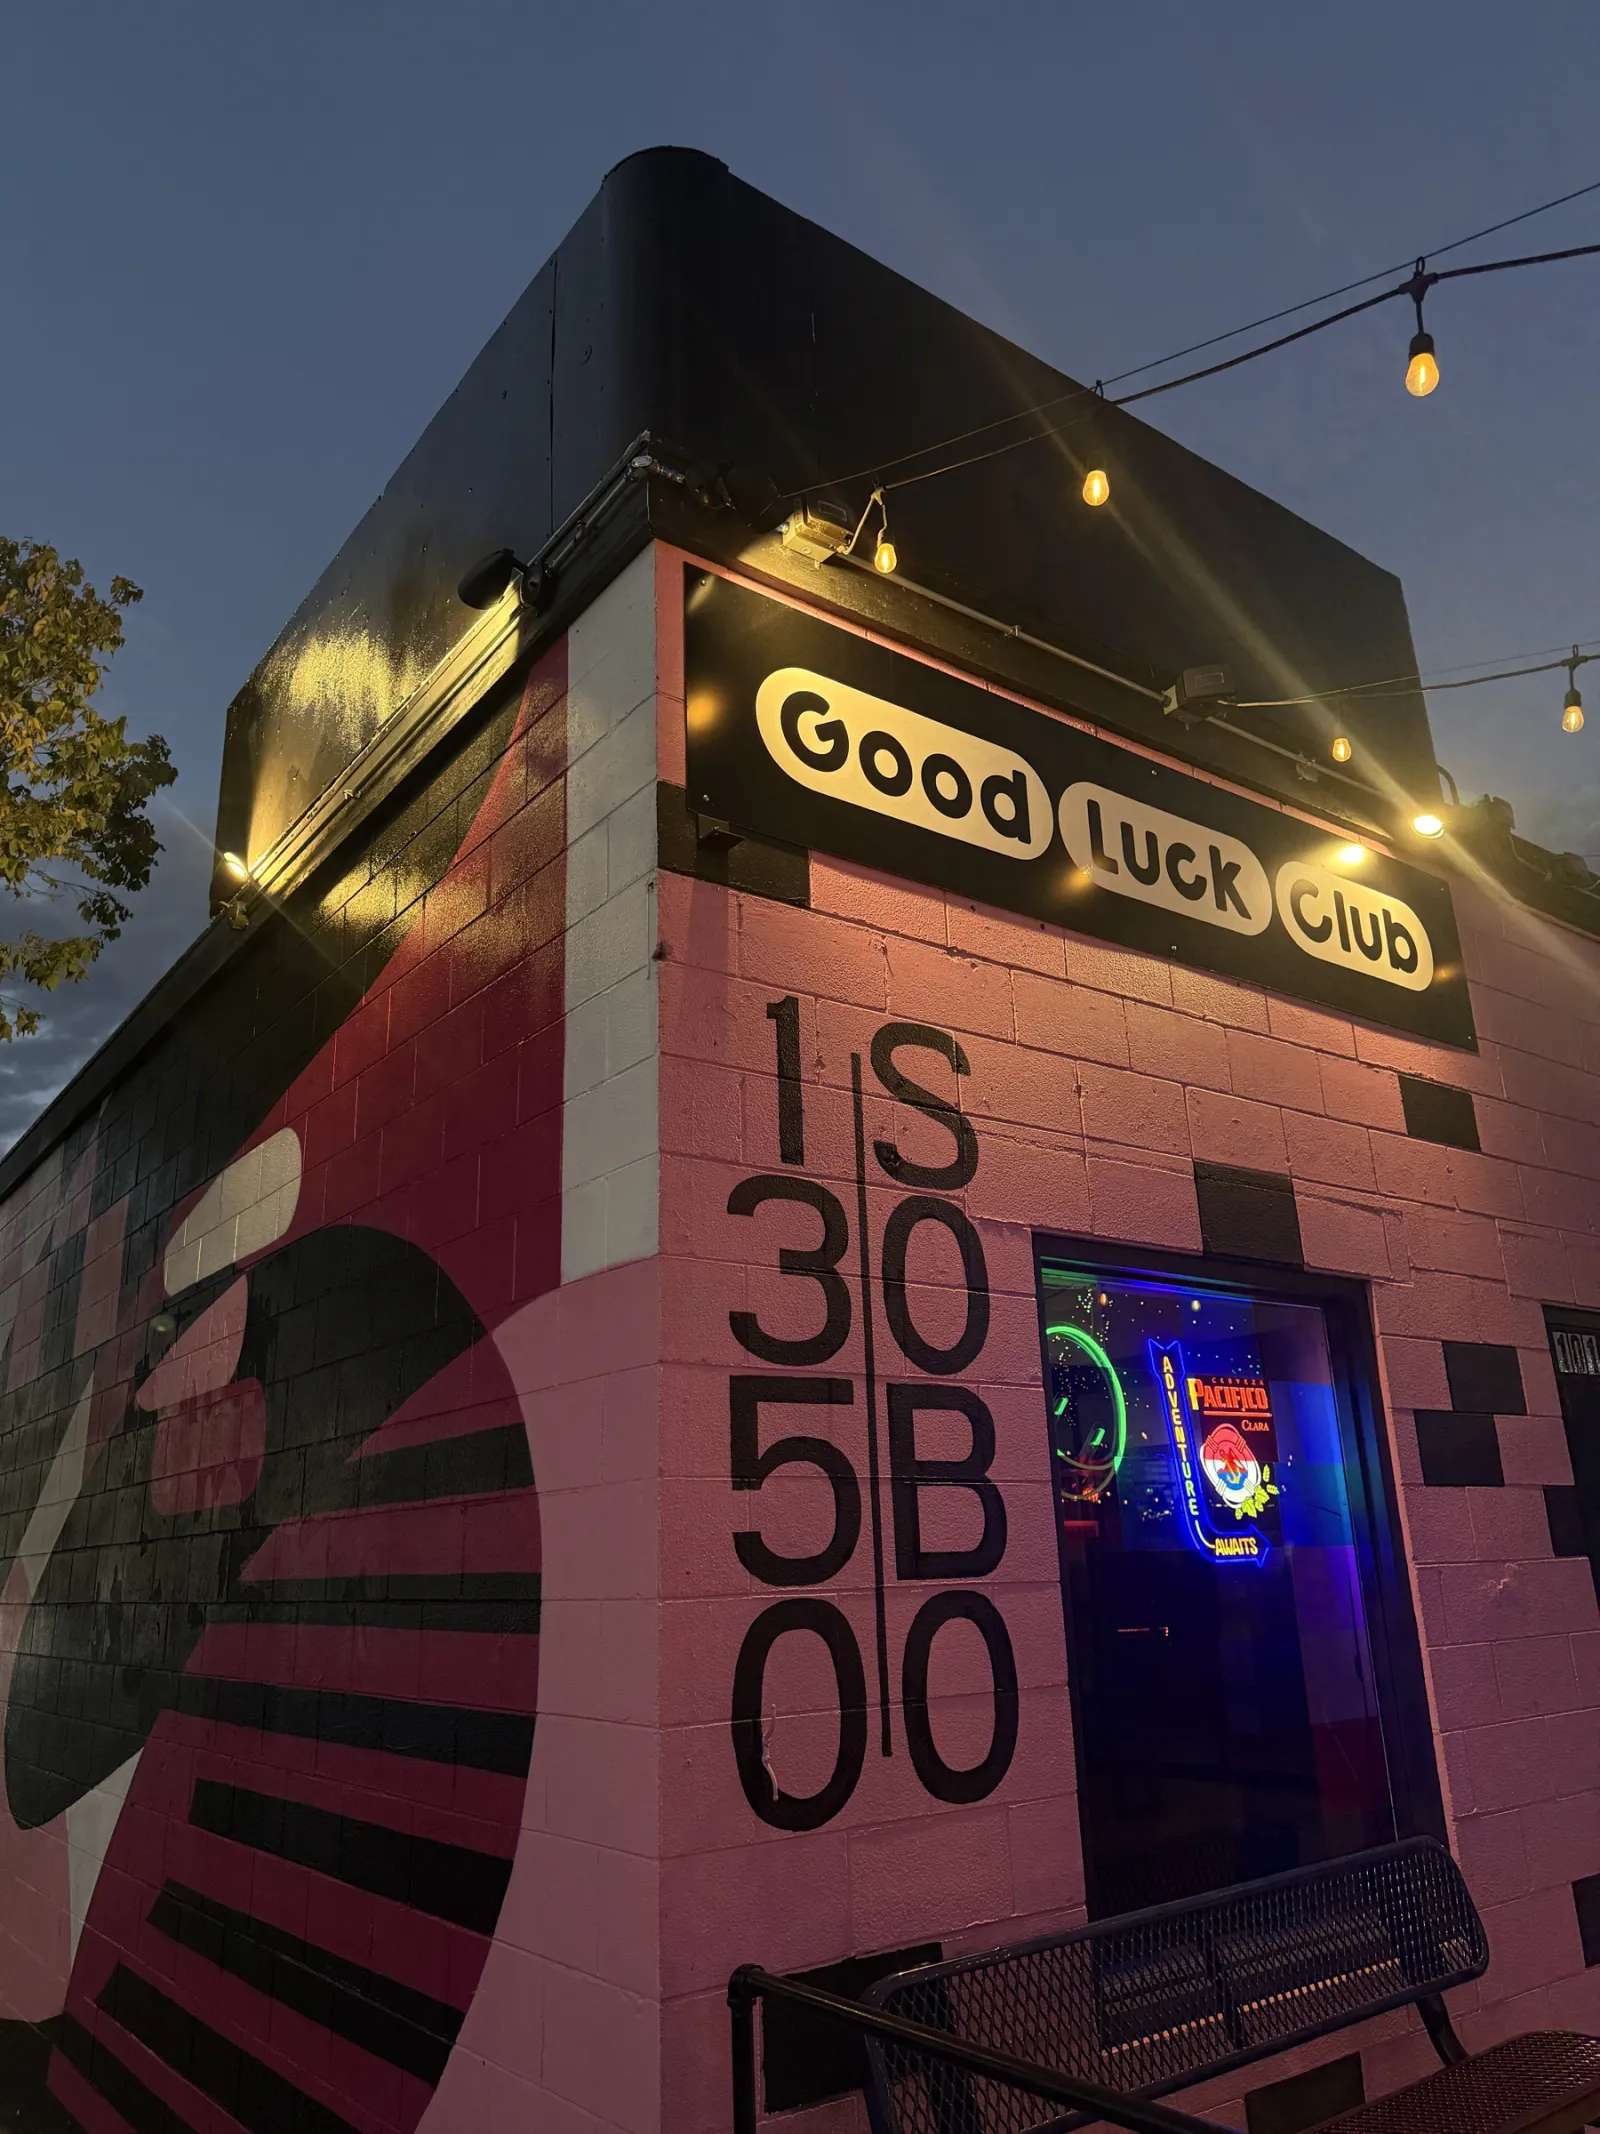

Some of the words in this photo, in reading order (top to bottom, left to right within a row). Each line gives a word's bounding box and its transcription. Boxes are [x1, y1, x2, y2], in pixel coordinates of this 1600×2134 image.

[780, 690, 1032, 845] Good
[1290, 879, 1419, 974] Club
[727, 994, 868, 1832] 1350
[1163, 1355, 1200, 1517] ADVENTURE
[1211, 1376, 1265, 1386] CERVEZA
[1215, 1537, 1259, 1556] AWAITS
